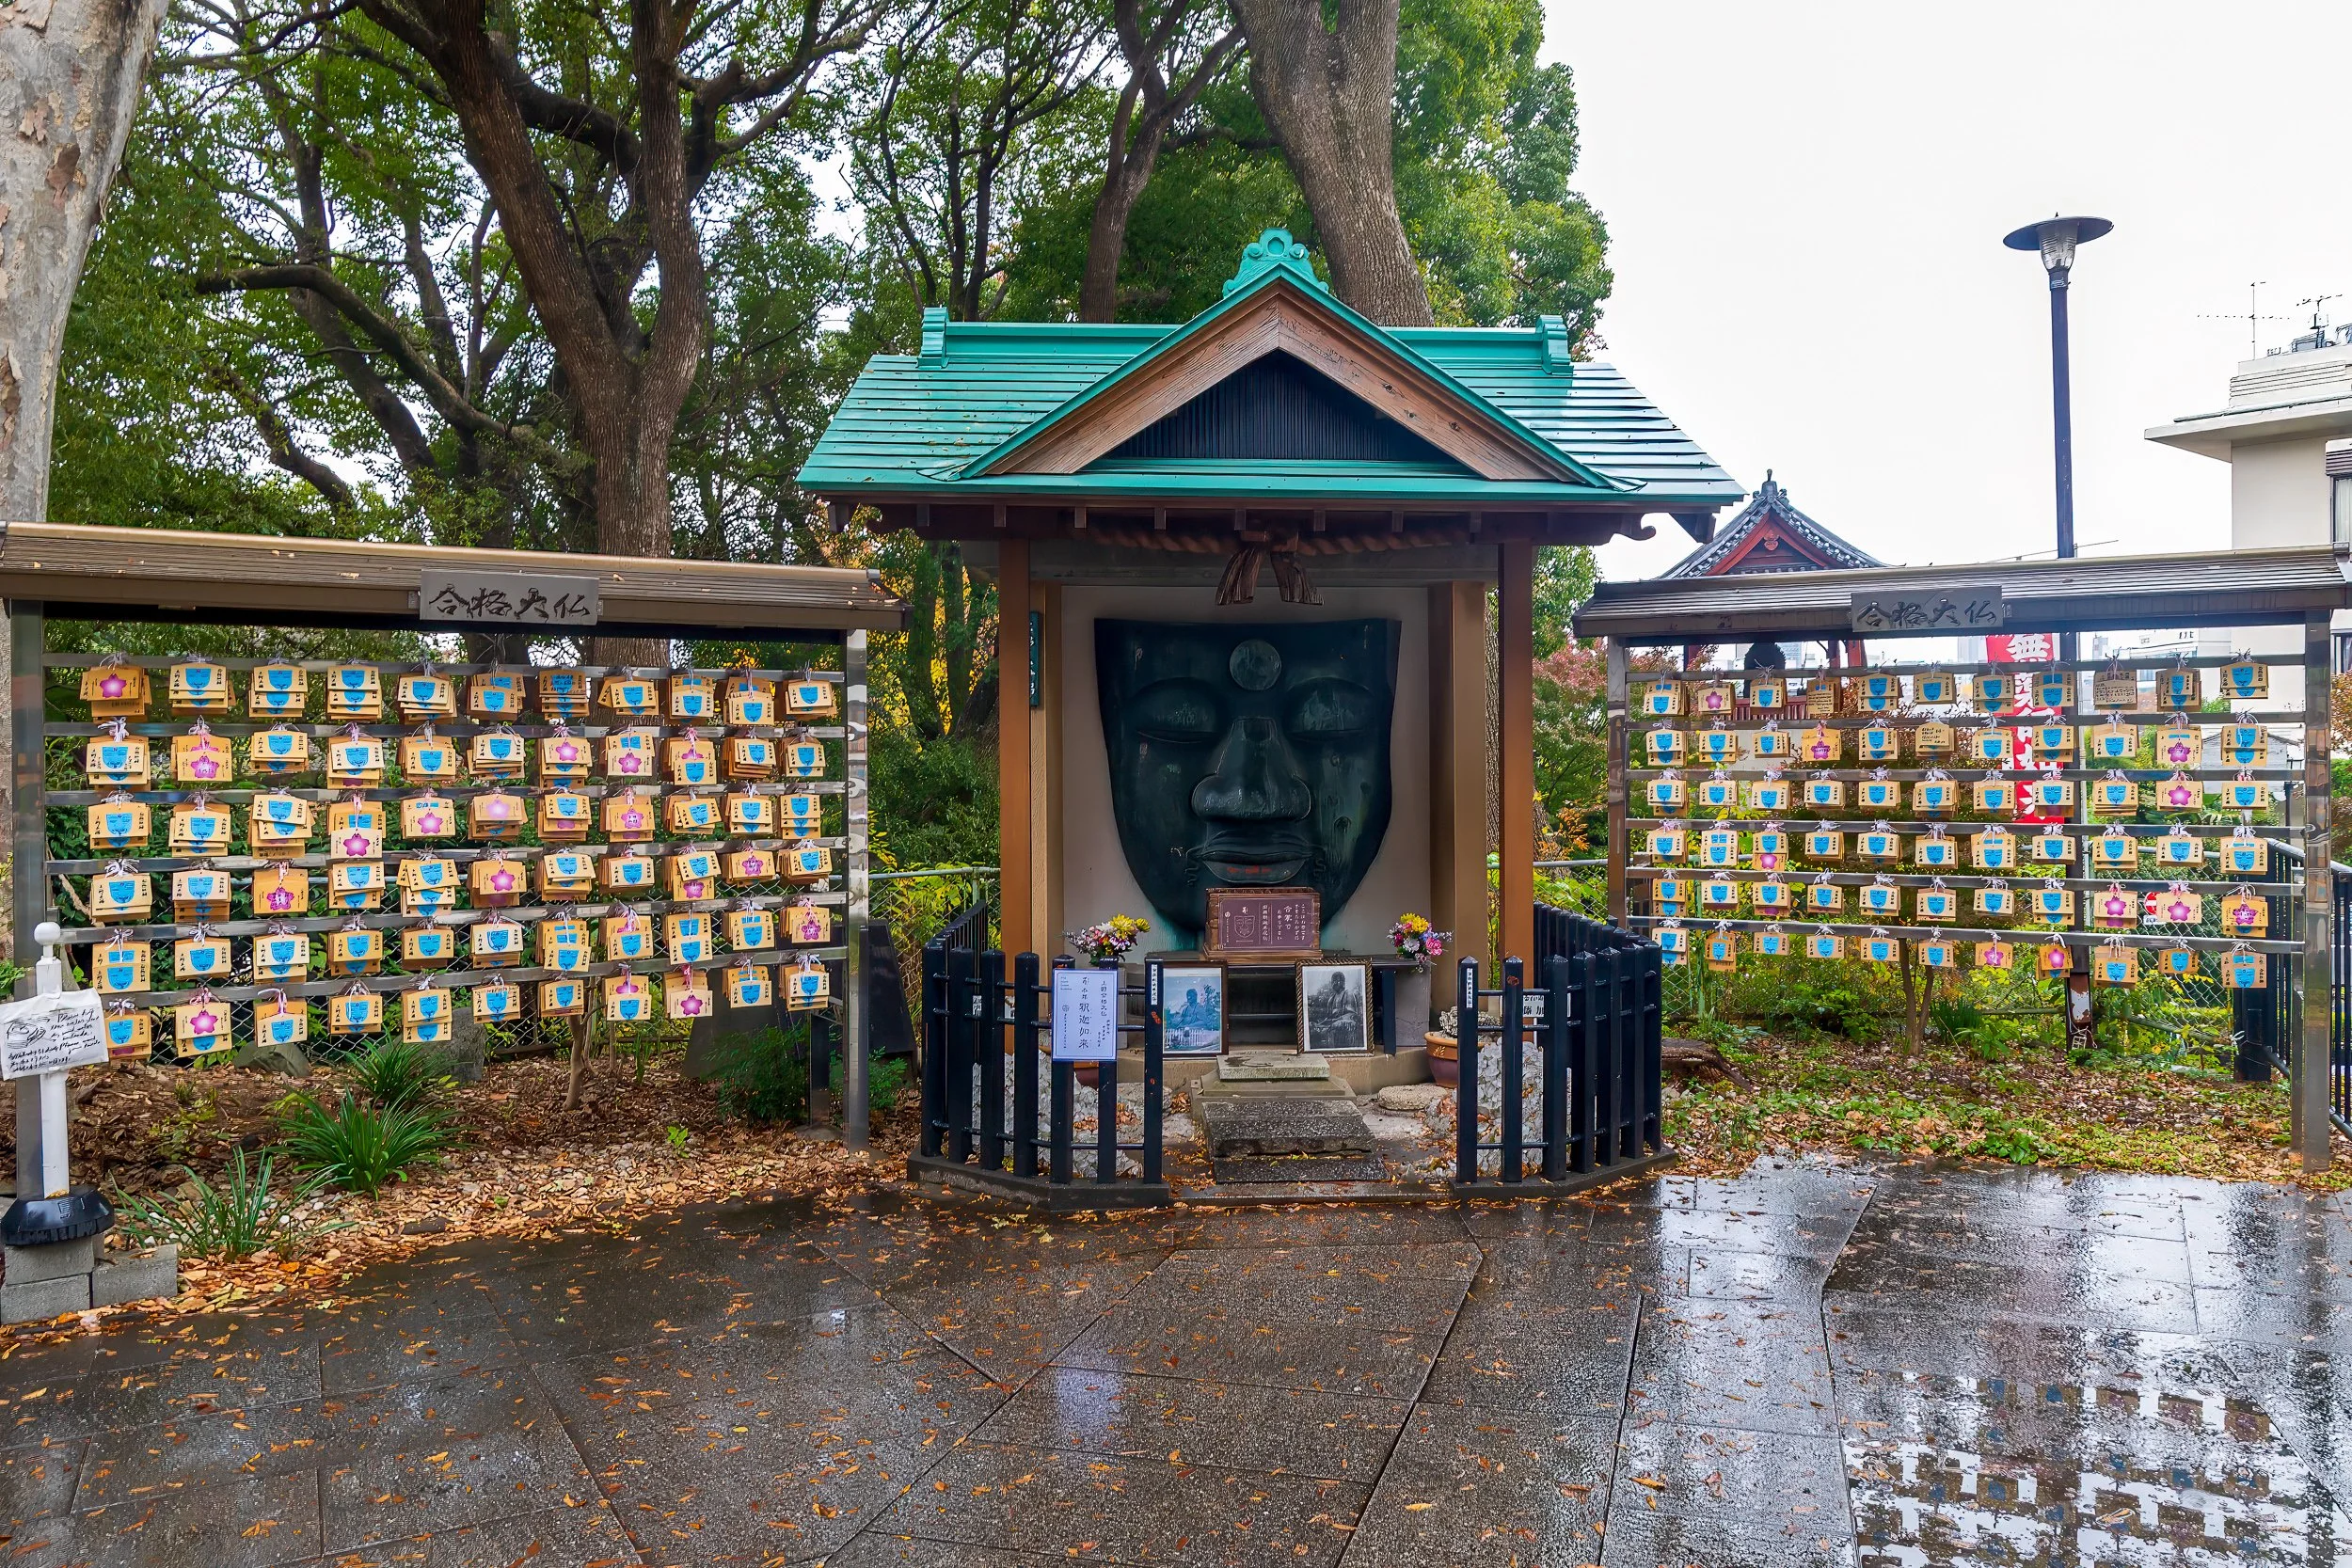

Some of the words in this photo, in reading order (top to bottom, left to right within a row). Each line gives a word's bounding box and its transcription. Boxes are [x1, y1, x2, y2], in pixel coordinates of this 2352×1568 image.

[428, 583, 590, 623] 合格大仏
[1857, 598, 1996, 627] 合格大仏
